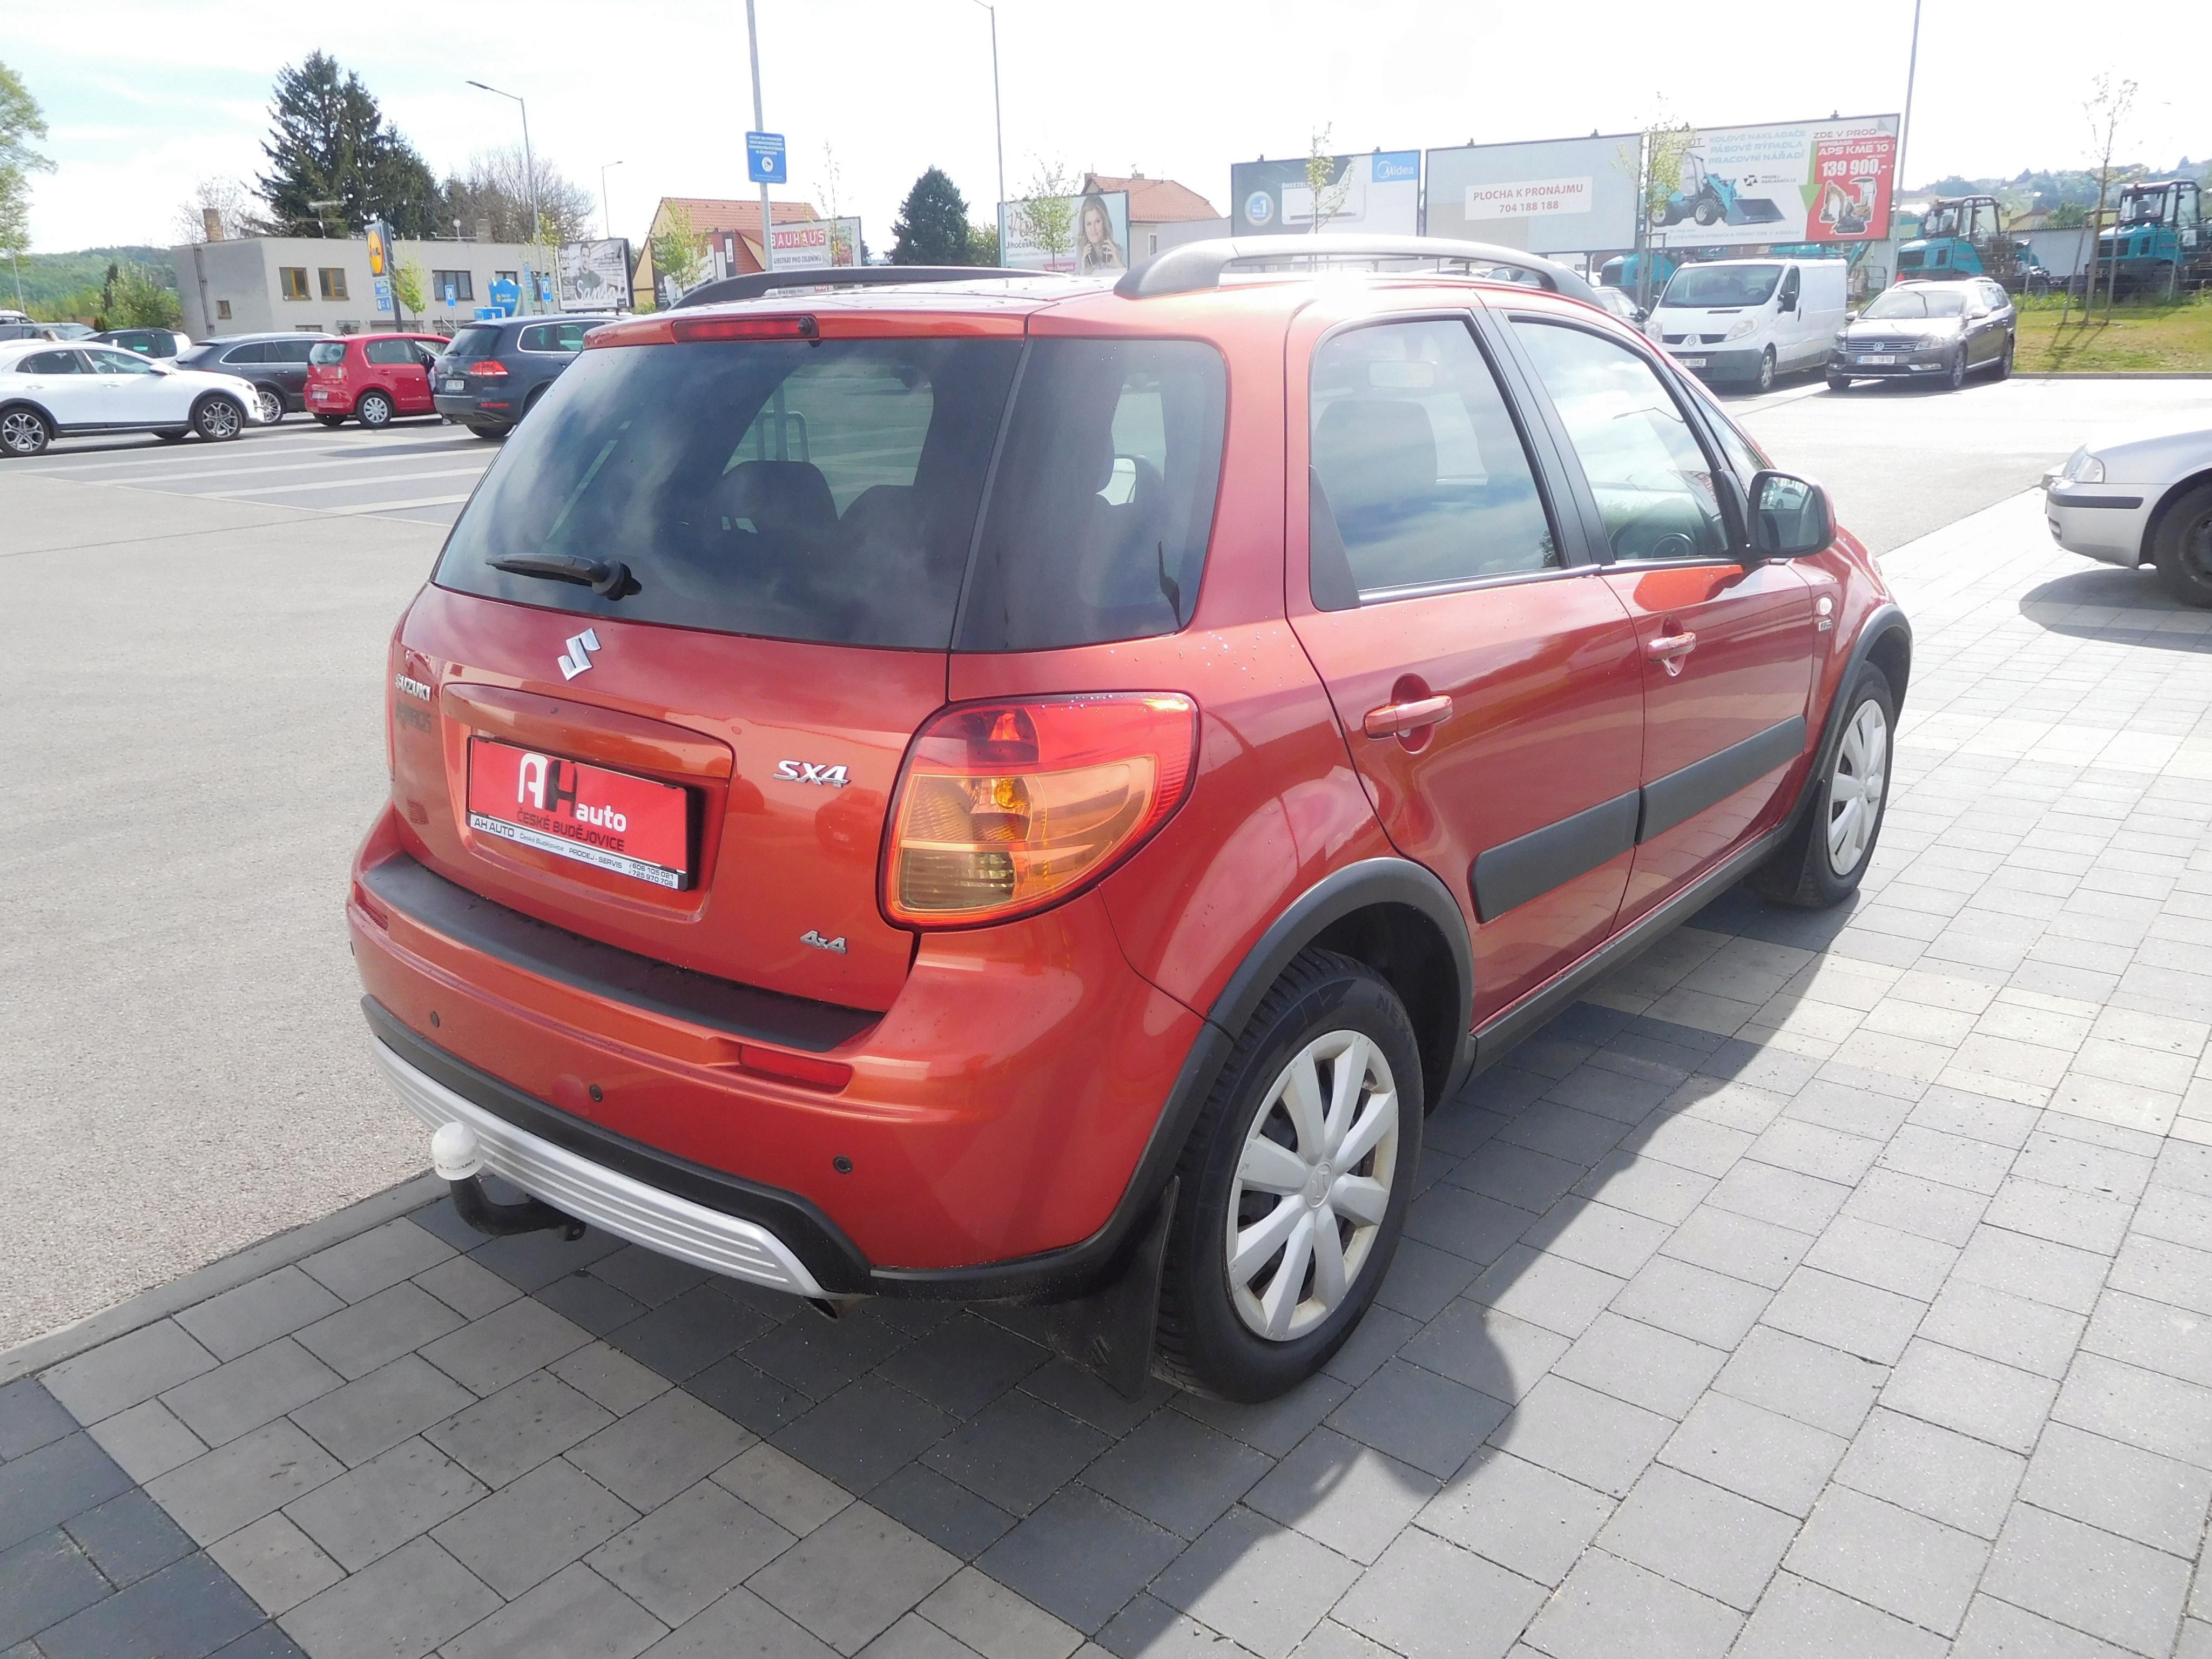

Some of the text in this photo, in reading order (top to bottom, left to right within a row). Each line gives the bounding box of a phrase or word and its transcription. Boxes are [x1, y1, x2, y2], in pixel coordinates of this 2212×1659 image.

[1818, 144, 1889, 156] APS KME 10
[1379, 161, 1413, 177] Midea
[1822, 160, 1847, 177] 139
[1473, 183, 1583, 201] PLOCHA K PRONÁJMU
[1499, 200, 1559, 213] 704 188 188
[771, 230, 825, 246] BAUHAUS
[395, 673, 431, 702] SUZUKI
[772, 760, 851, 788] SX4
[474, 818, 515, 838] AH AUTO
[517, 807, 625, 852] ČESKÉ BUDĚJOVICE
[800, 930, 847, 955] 4x4
